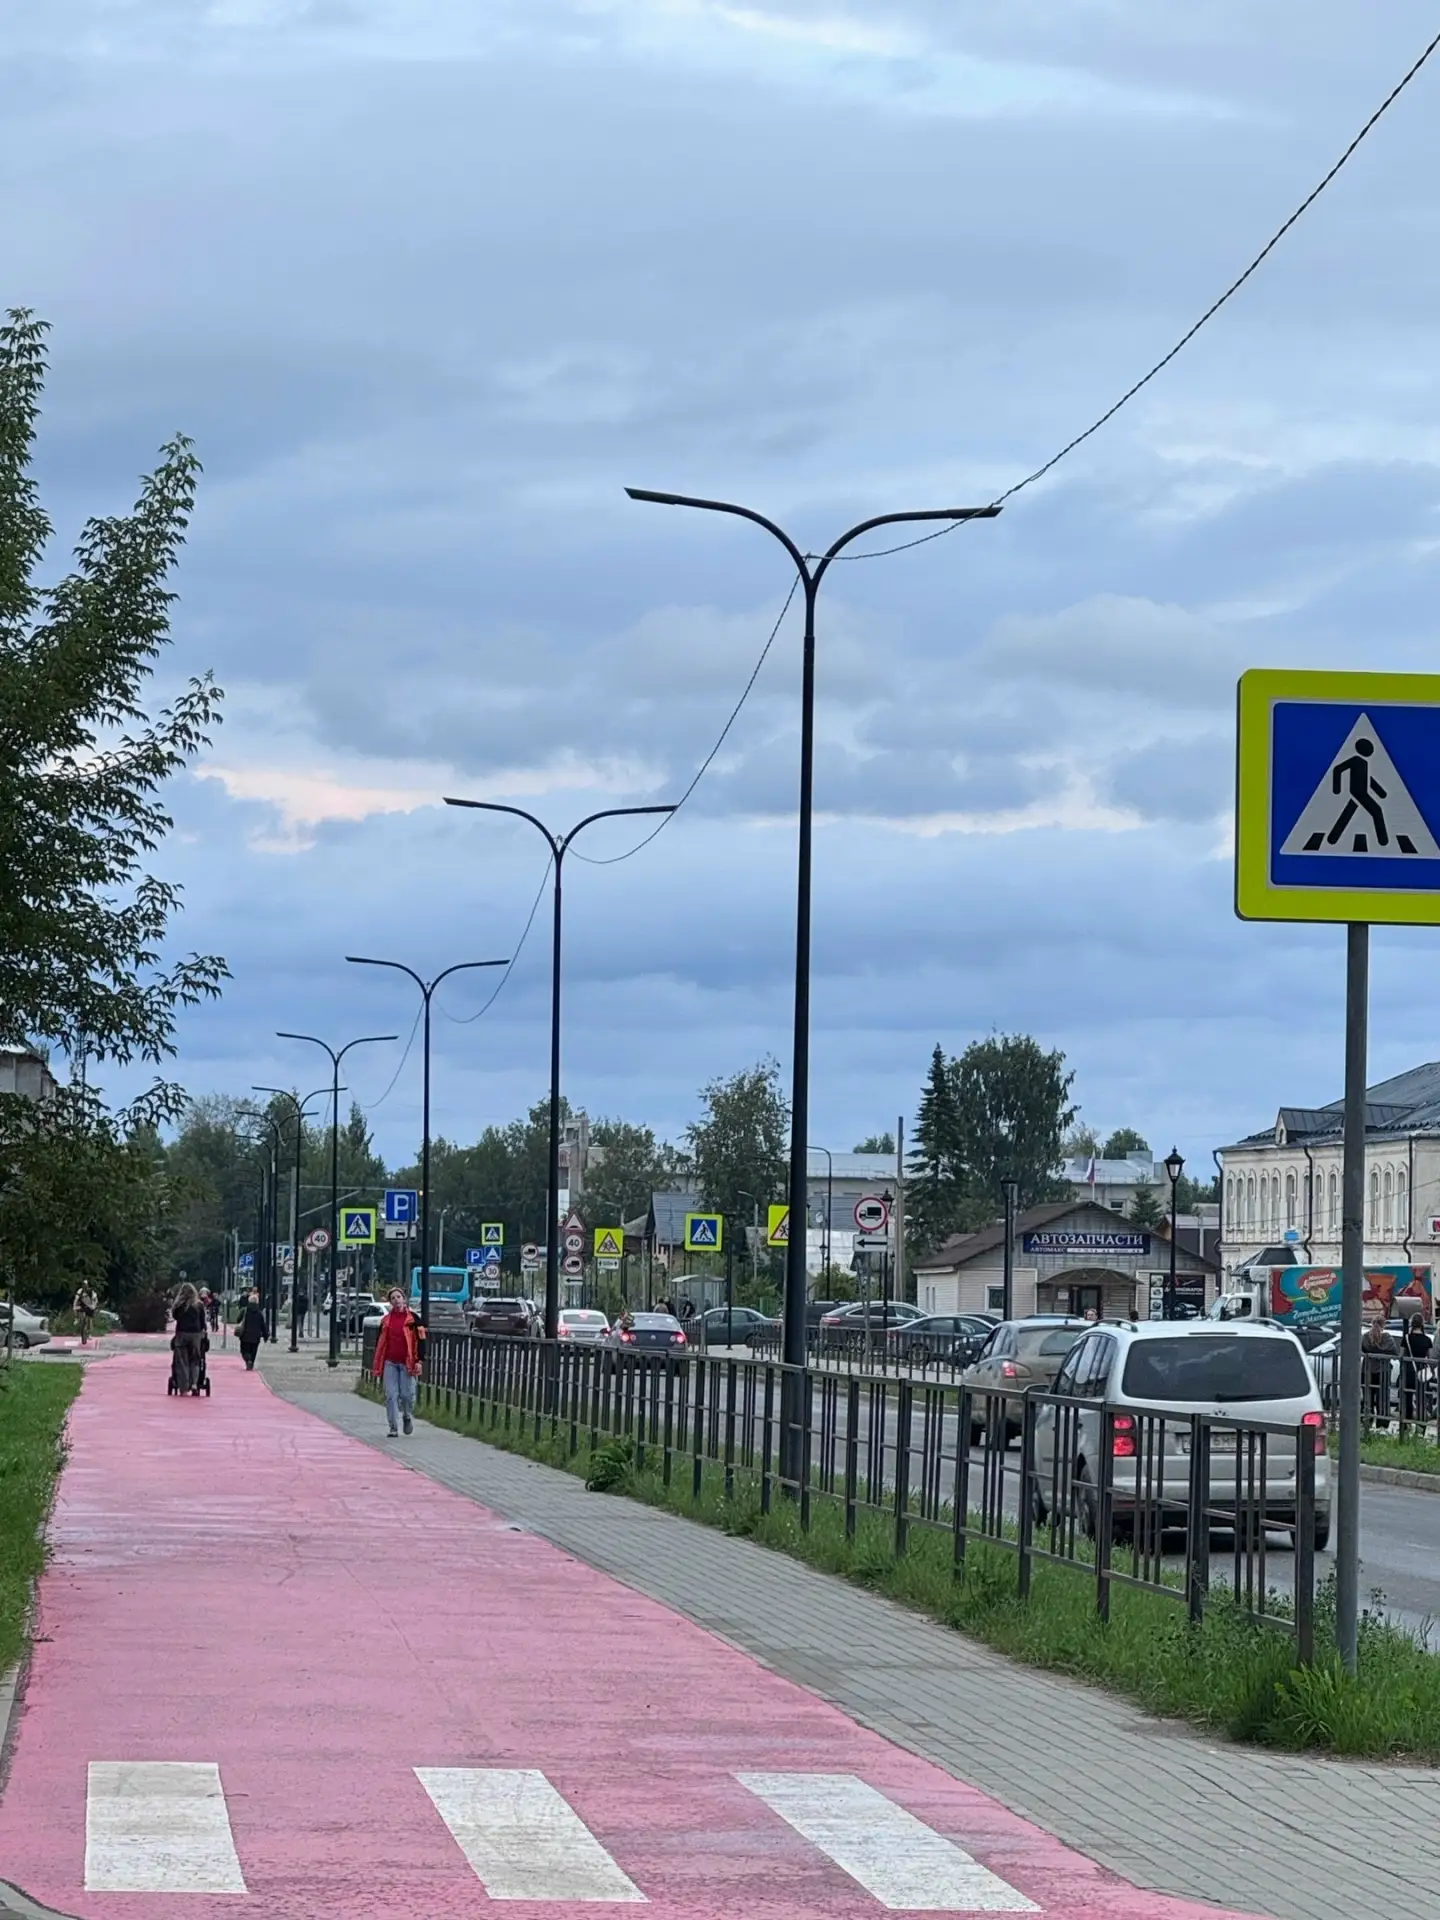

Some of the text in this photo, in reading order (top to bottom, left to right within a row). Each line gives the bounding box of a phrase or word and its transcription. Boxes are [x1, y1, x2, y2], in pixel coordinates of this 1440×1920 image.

[394, 1194, 409, 1219] P
[315, 1234, 326, 1243] 40
[568, 1238, 581, 1248] 40
[1030, 1234, 1143, 1245] АВТОЗАПЧАСТИ
[471, 1250, 480, 1263] P
[488, 1267, 497, 1276] 30
